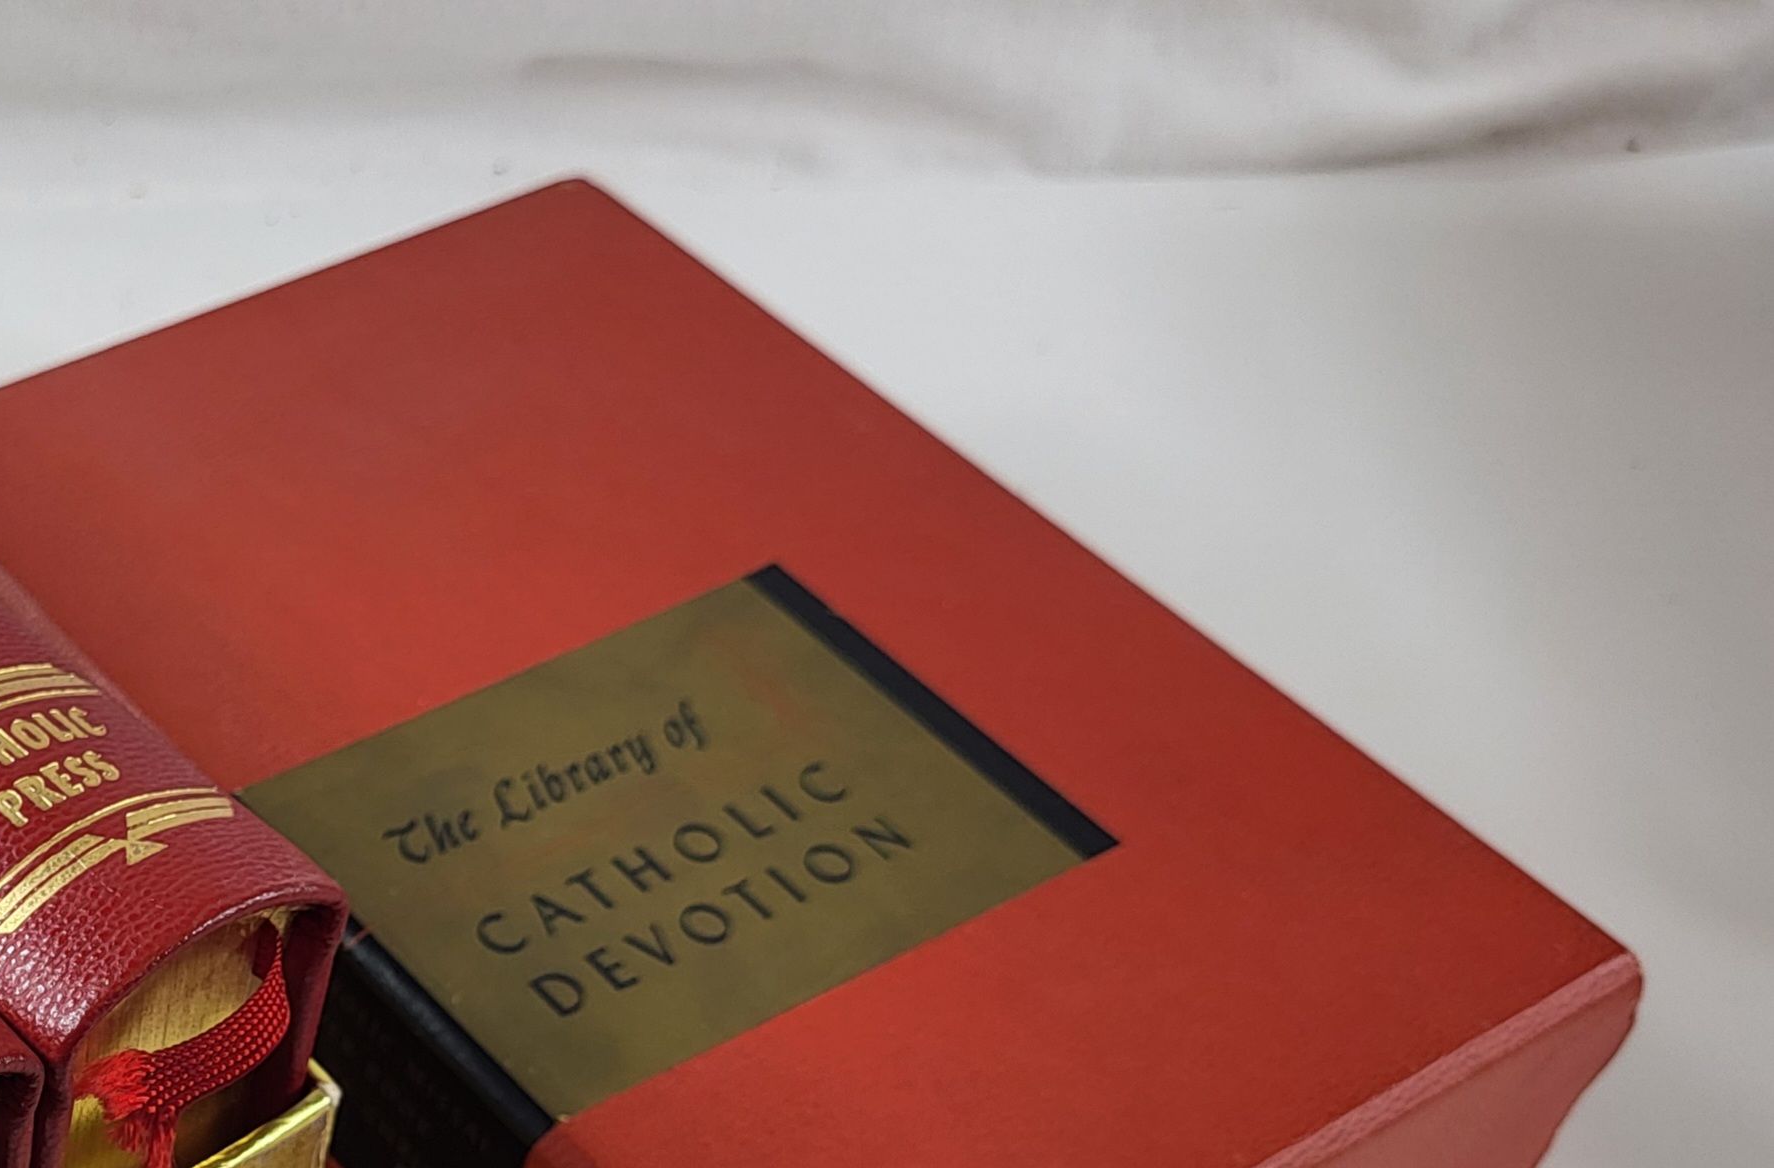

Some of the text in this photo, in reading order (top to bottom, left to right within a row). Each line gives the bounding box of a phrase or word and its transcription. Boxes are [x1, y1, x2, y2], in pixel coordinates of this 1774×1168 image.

[382, 699, 709, 865] The Library of
[475, 760, 848, 955] CATHOLIC
[530, 815, 914, 1018] DEVOTION
